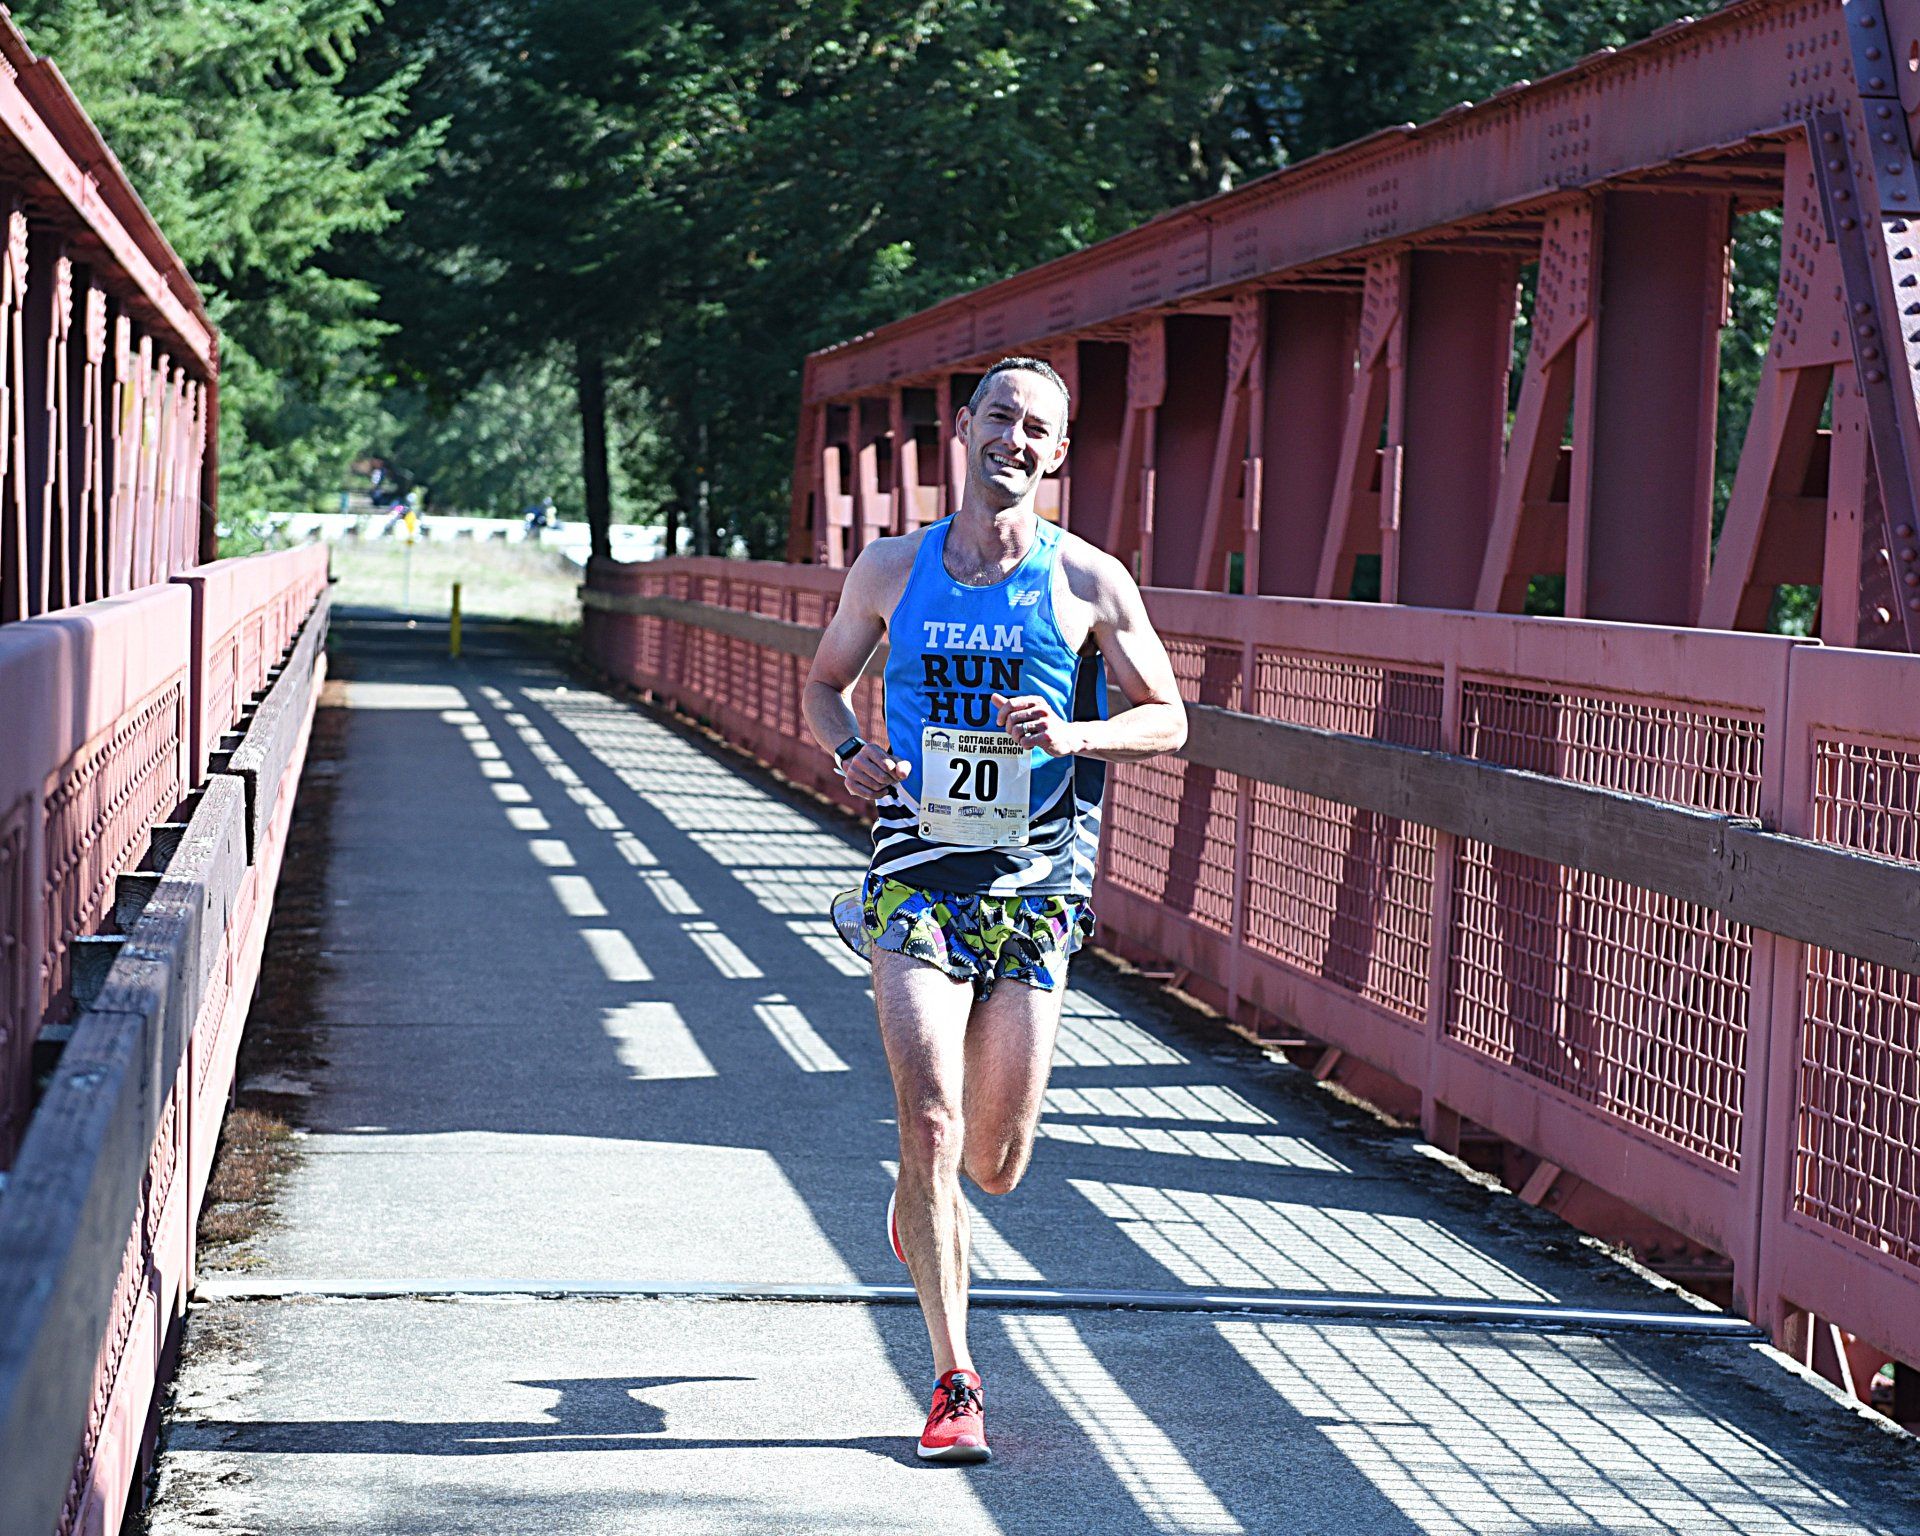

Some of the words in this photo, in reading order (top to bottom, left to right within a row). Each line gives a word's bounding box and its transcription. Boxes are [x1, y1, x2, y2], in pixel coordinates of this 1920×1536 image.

[923, 621, 1024, 653] TEAM
[921, 654, 1024, 690] RUN
[925, 691, 1005, 727] HU
[958, 735, 995, 746] COTTAGE
[997, 736, 1022, 747] GRO
[958, 745, 977, 754] HALF
[979, 745, 1024, 755] MARATHON
[948, 757, 999, 802] 20
